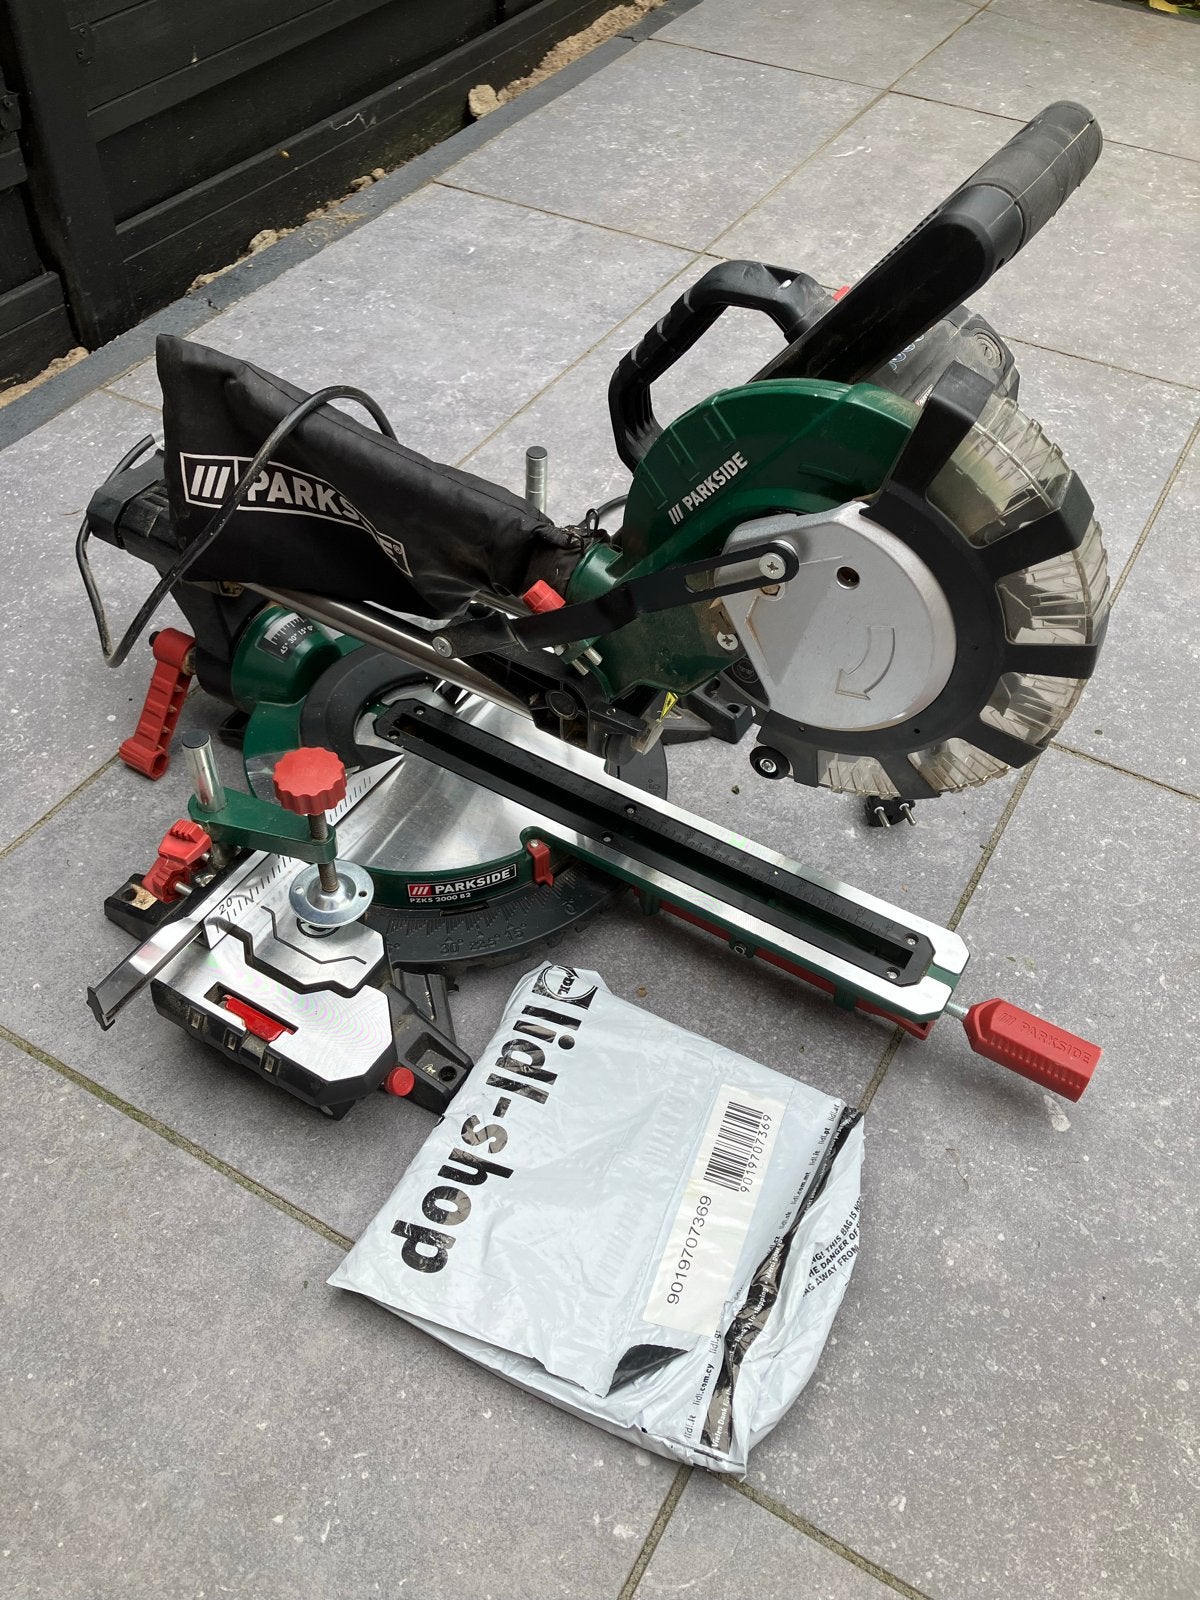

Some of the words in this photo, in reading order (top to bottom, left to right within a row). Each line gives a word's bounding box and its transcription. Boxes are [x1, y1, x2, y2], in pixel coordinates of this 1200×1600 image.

[682, 451, 748, 511] PARKSIDE
[435, 869, 511, 894] PARKSIDE
[435, 894, 458, 902] 2000
[218, 897, 233, 915] 20
[1020, 1021, 1092, 1065] PARKSIDE
[391, 1005, 582, 1274] lidl-shop
[739, 1113, 772, 1193] 9019707369
[666, 1195, 712, 1305] 9019707369
[820, 1239, 849, 1269] DANGER
[848, 1229, 859, 1241] OF
[825, 1235, 842, 1252] THIS
[840, 1220, 853, 1236] BAG
[849, 1211, 857, 1220] IS
[765, 1261, 776, 1279] Merci
[816, 1265, 837, 1286] AWAY
[837, 1244, 860, 1266] FROM
[693, 1363, 715, 1406] lidl.com.cy
[711, 1424, 723, 1448] Vielen
[717, 1407, 728, 1424] Dank
